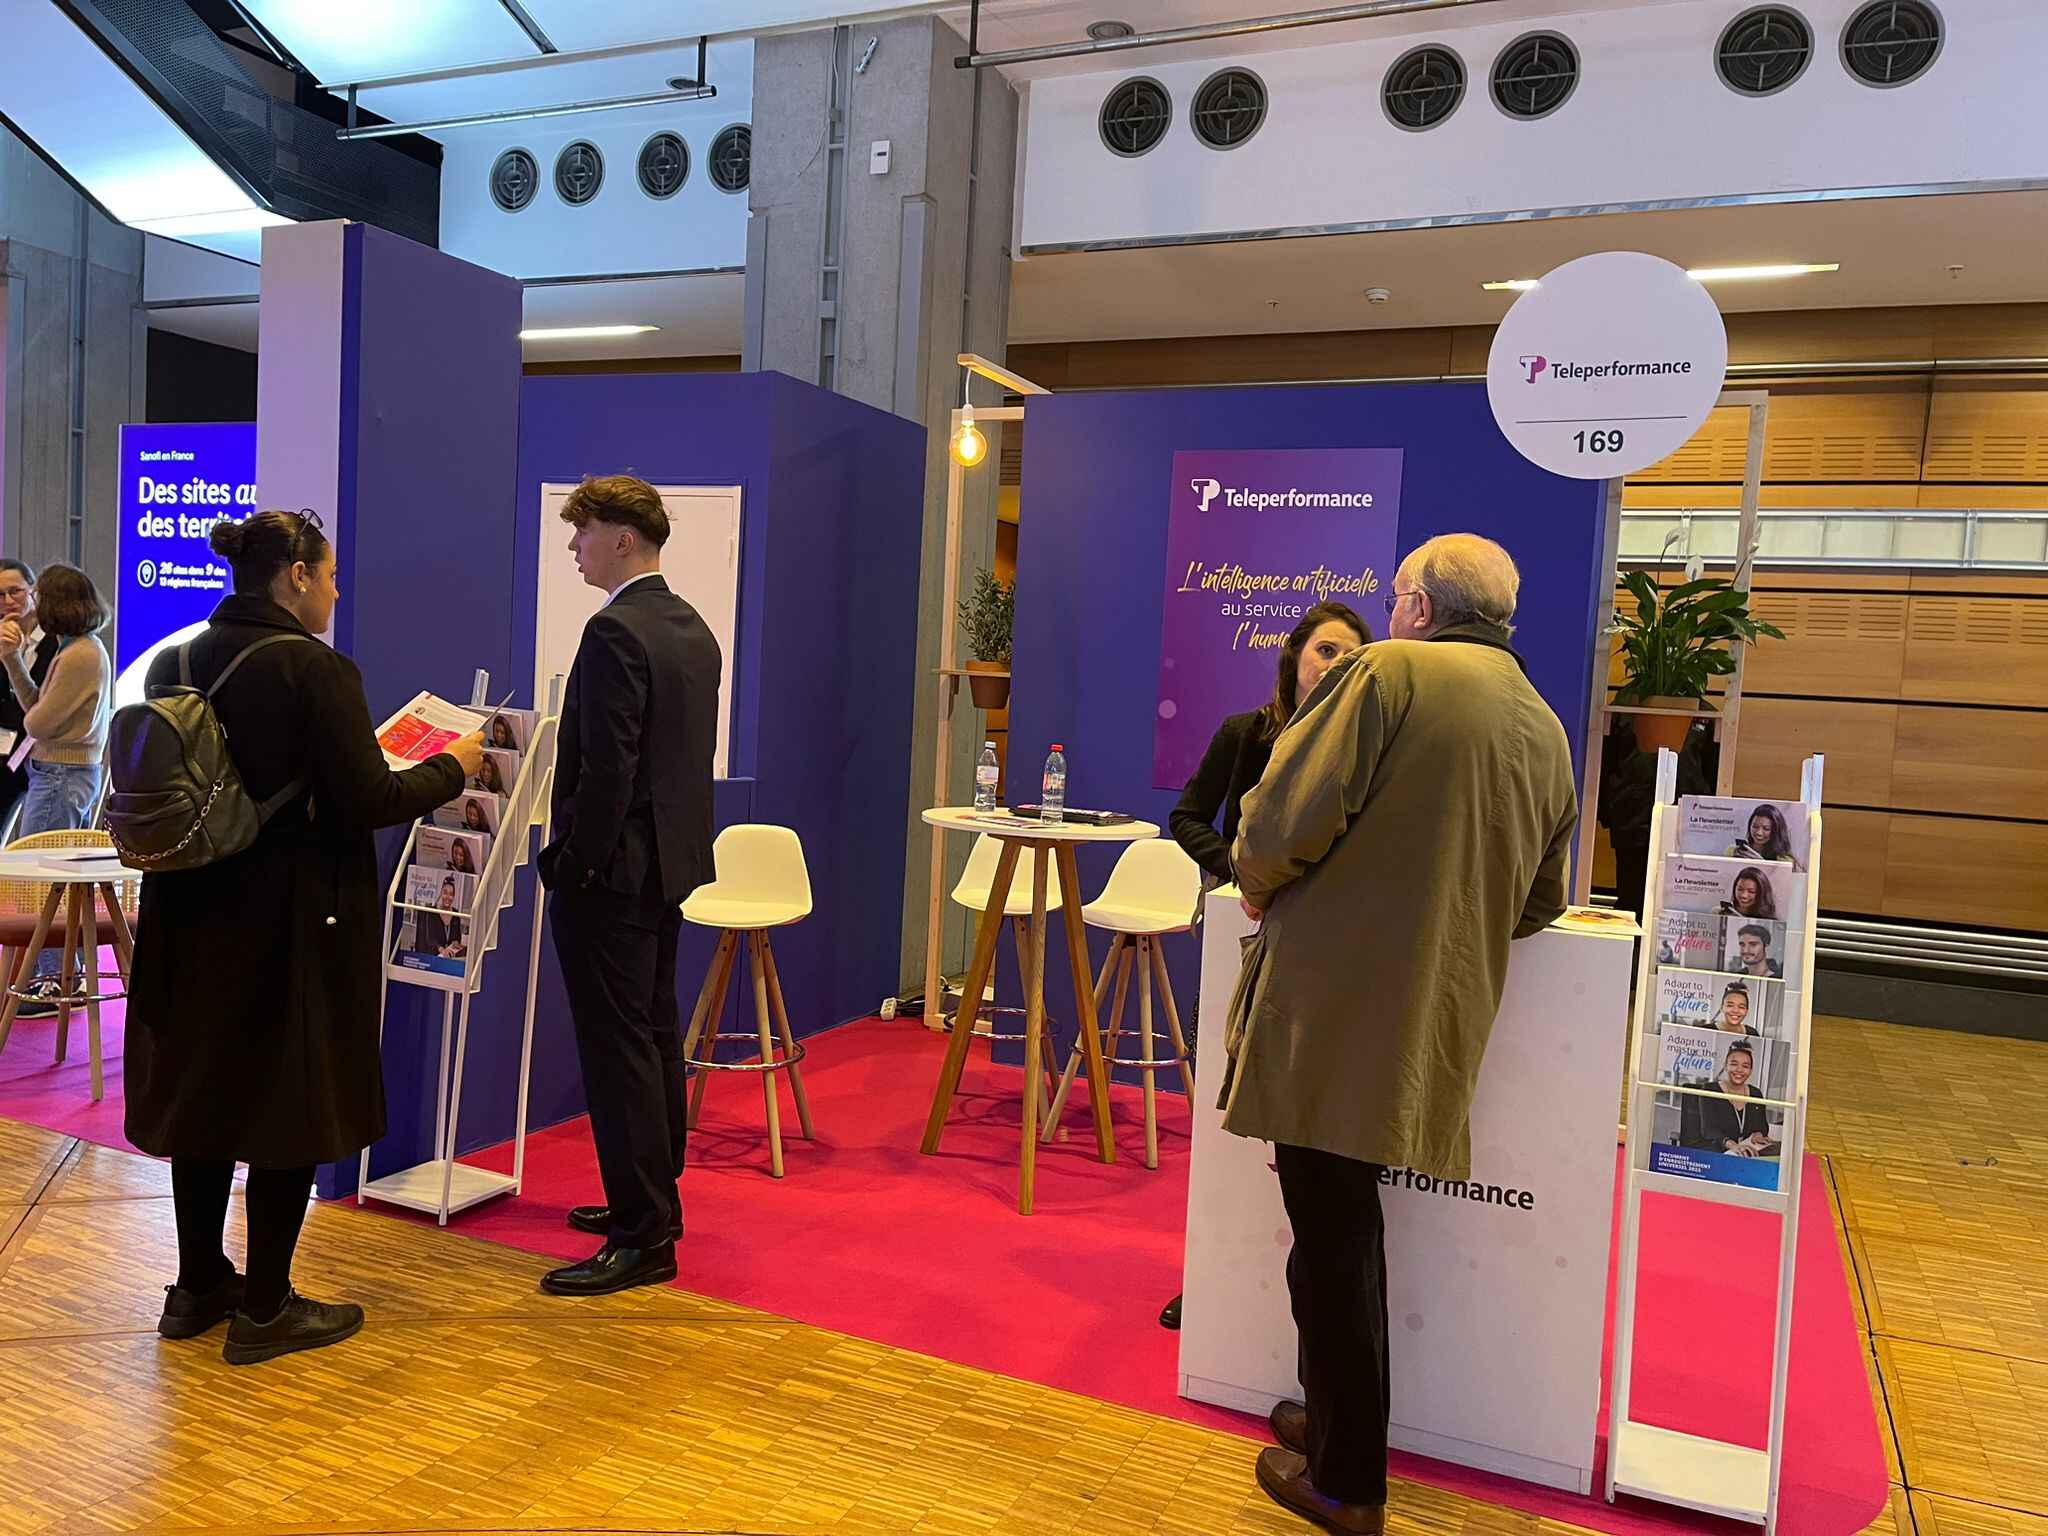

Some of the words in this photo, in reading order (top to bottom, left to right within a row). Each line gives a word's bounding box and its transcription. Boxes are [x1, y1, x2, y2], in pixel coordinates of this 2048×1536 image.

[1552, 360, 1691, 381] Teleperformance
[1573, 430, 1624, 453] 169
[140, 451, 161, 460] Sanofi
[162, 452, 170, 460] en
[171, 451, 194, 460] France
[139, 477, 177, 504] Des
[182, 477, 231, 504] sites
[1224, 487, 1373, 511] Teleperformance
[138, 510, 175, 537] des
[160, 562, 173, 574] 26
[206, 563, 214, 576] 9
[1177, 561, 1289, 599] L'intelligence
[1292, 565, 1379, 601] artificielle
[1221, 604, 1241, 615] au
[1245, 603, 1301, 618] service
[1669, 918, 1695, 929] Adapt
[1697, 919, 1706, 928] to
[1702, 929, 1716, 938] the
[1674, 934, 1712, 953] future
[1664, 979, 1691, 990] Adapt
[1693, 980, 1702, 991] to
[1699, 990, 1713, 1000] the
[1671, 995, 1710, 1015] future
[1668, 1035, 1695, 1047] Adapt
[1697, 1038, 1707, 1047] to
[1702, 1047, 1717, 1058] the
[1673, 1052, 1712, 1073] future
[1378, 1166, 1534, 1210] erformance
